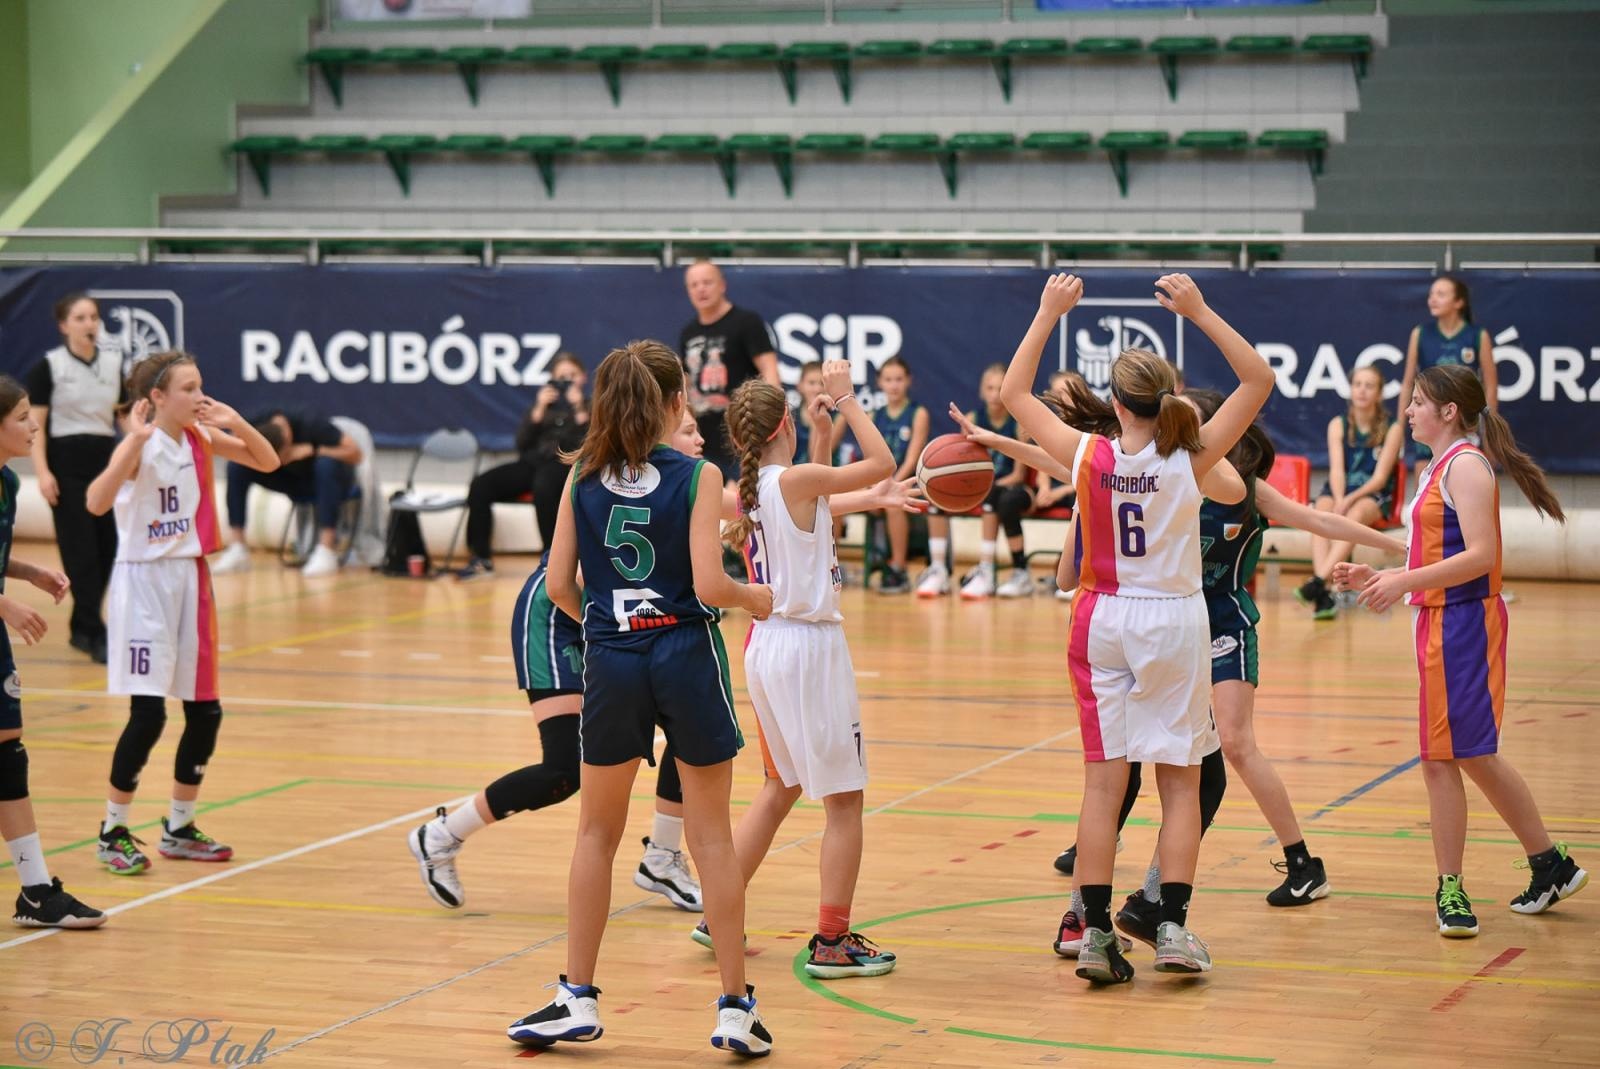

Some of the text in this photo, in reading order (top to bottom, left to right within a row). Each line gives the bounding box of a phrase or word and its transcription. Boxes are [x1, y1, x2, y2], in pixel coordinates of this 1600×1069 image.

[241, 314, 561, 386] RACIBÓRZ
[765, 313, 902, 385] SiR
[1255, 325, 1600, 402] RACÓR
[158, 485, 179, 514] 16
[1118, 502, 1146, 557] 6
[604, 504, 656, 582] 5
[130, 647, 151, 675] 16
